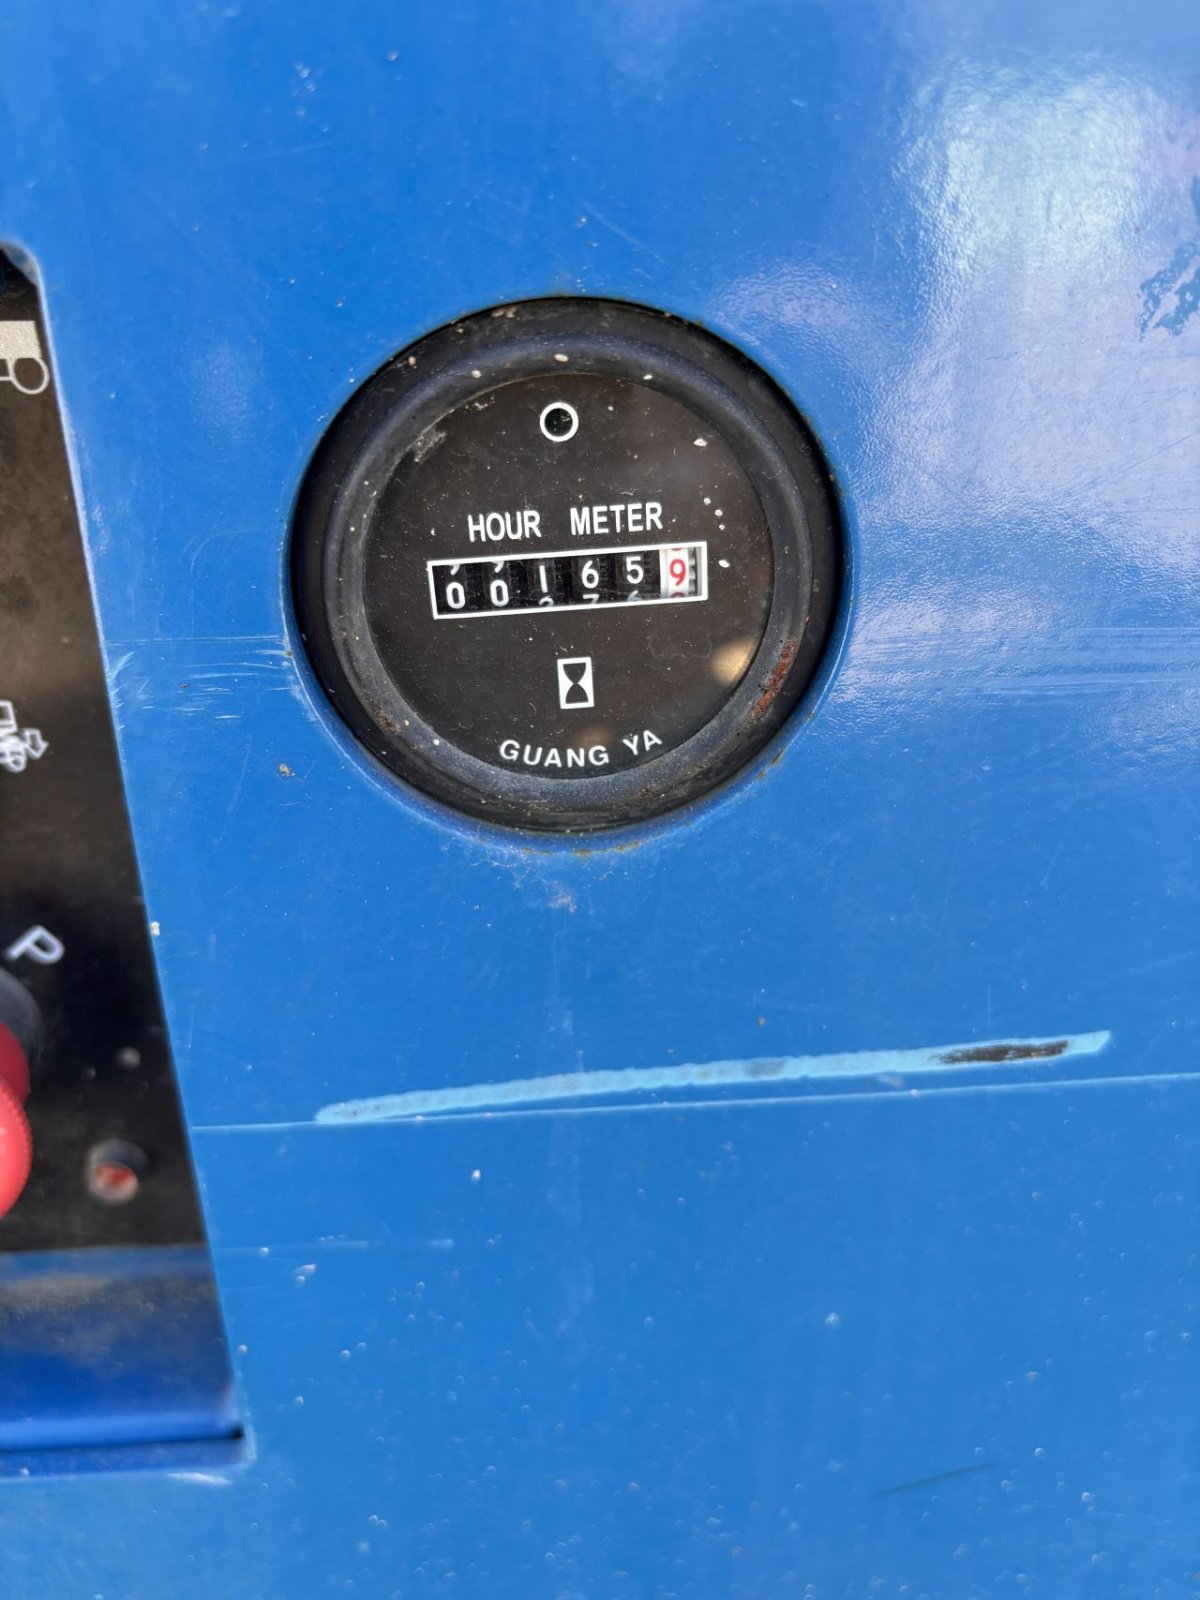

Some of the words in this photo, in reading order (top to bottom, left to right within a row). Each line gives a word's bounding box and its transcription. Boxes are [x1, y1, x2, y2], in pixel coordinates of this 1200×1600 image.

[467, 510, 542, 543] HOUR
[570, 502, 663, 536] METER
[498, 738, 610, 768] GUANG
[622, 729, 663, 757] YA
[6, 924, 65, 964] P
